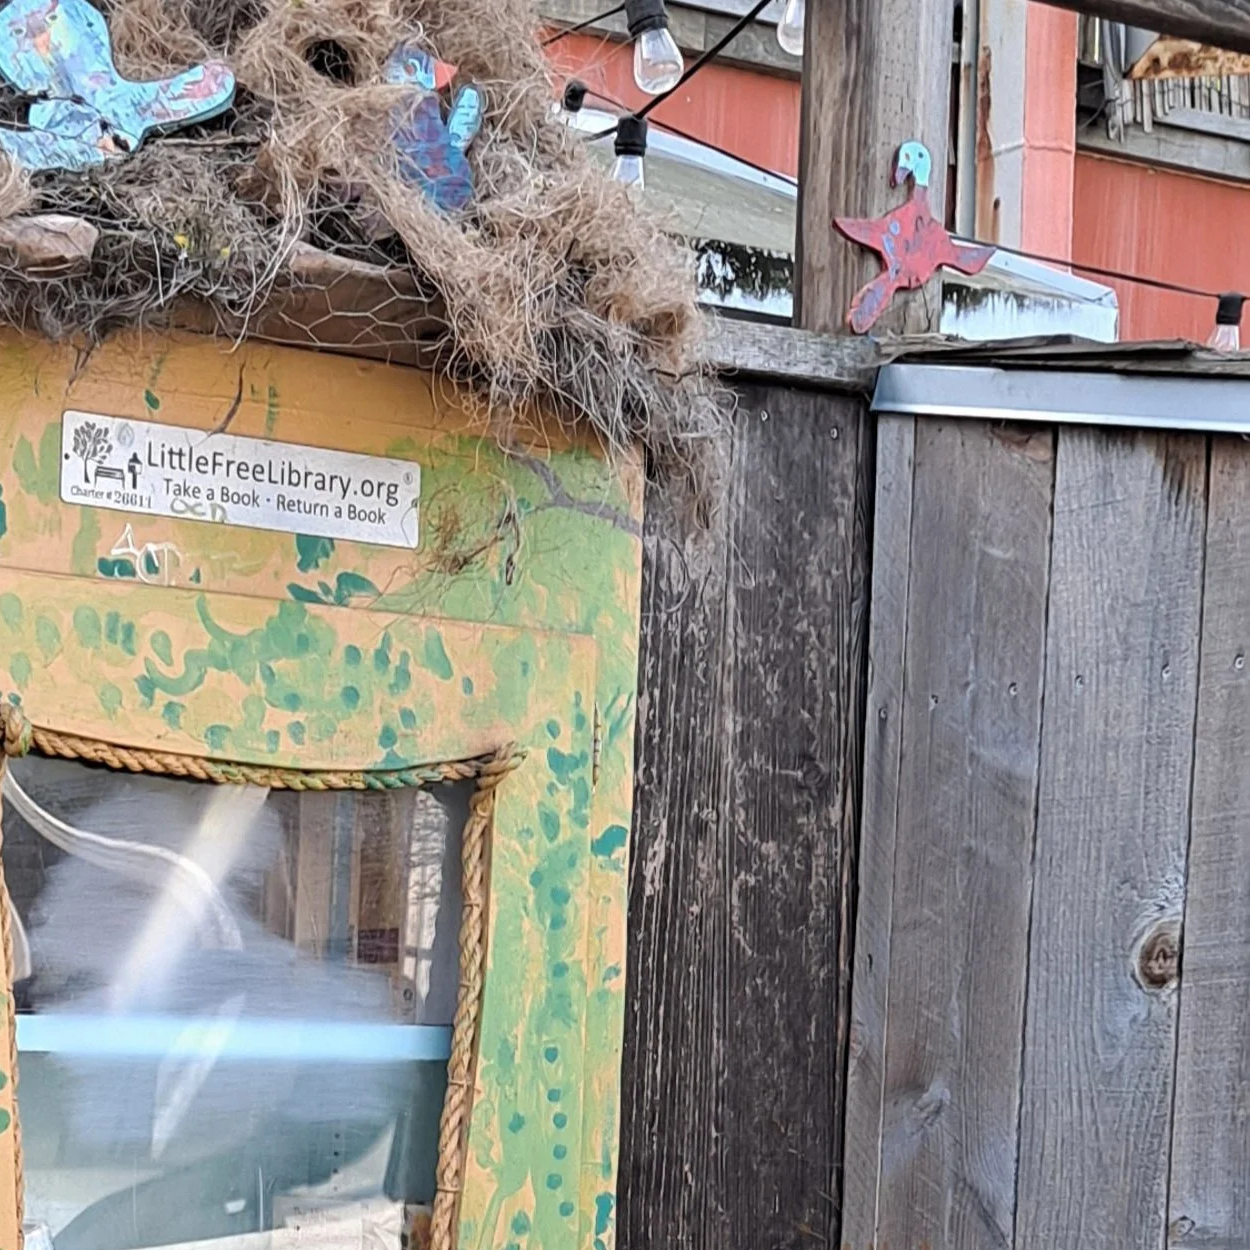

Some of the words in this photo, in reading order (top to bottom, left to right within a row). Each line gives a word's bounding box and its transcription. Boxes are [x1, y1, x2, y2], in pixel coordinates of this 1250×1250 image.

[71, 485, 104, 500] Charter
[147, 441, 399, 507] LittleFreeLibrary.org
[163, 478, 201, 499] Take
[206, 487, 215, 501] a
[220, 486, 260, 508] Book
[276, 494, 329, 518] Return
[334, 506, 342, 518] a
[347, 503, 386, 525] Book
